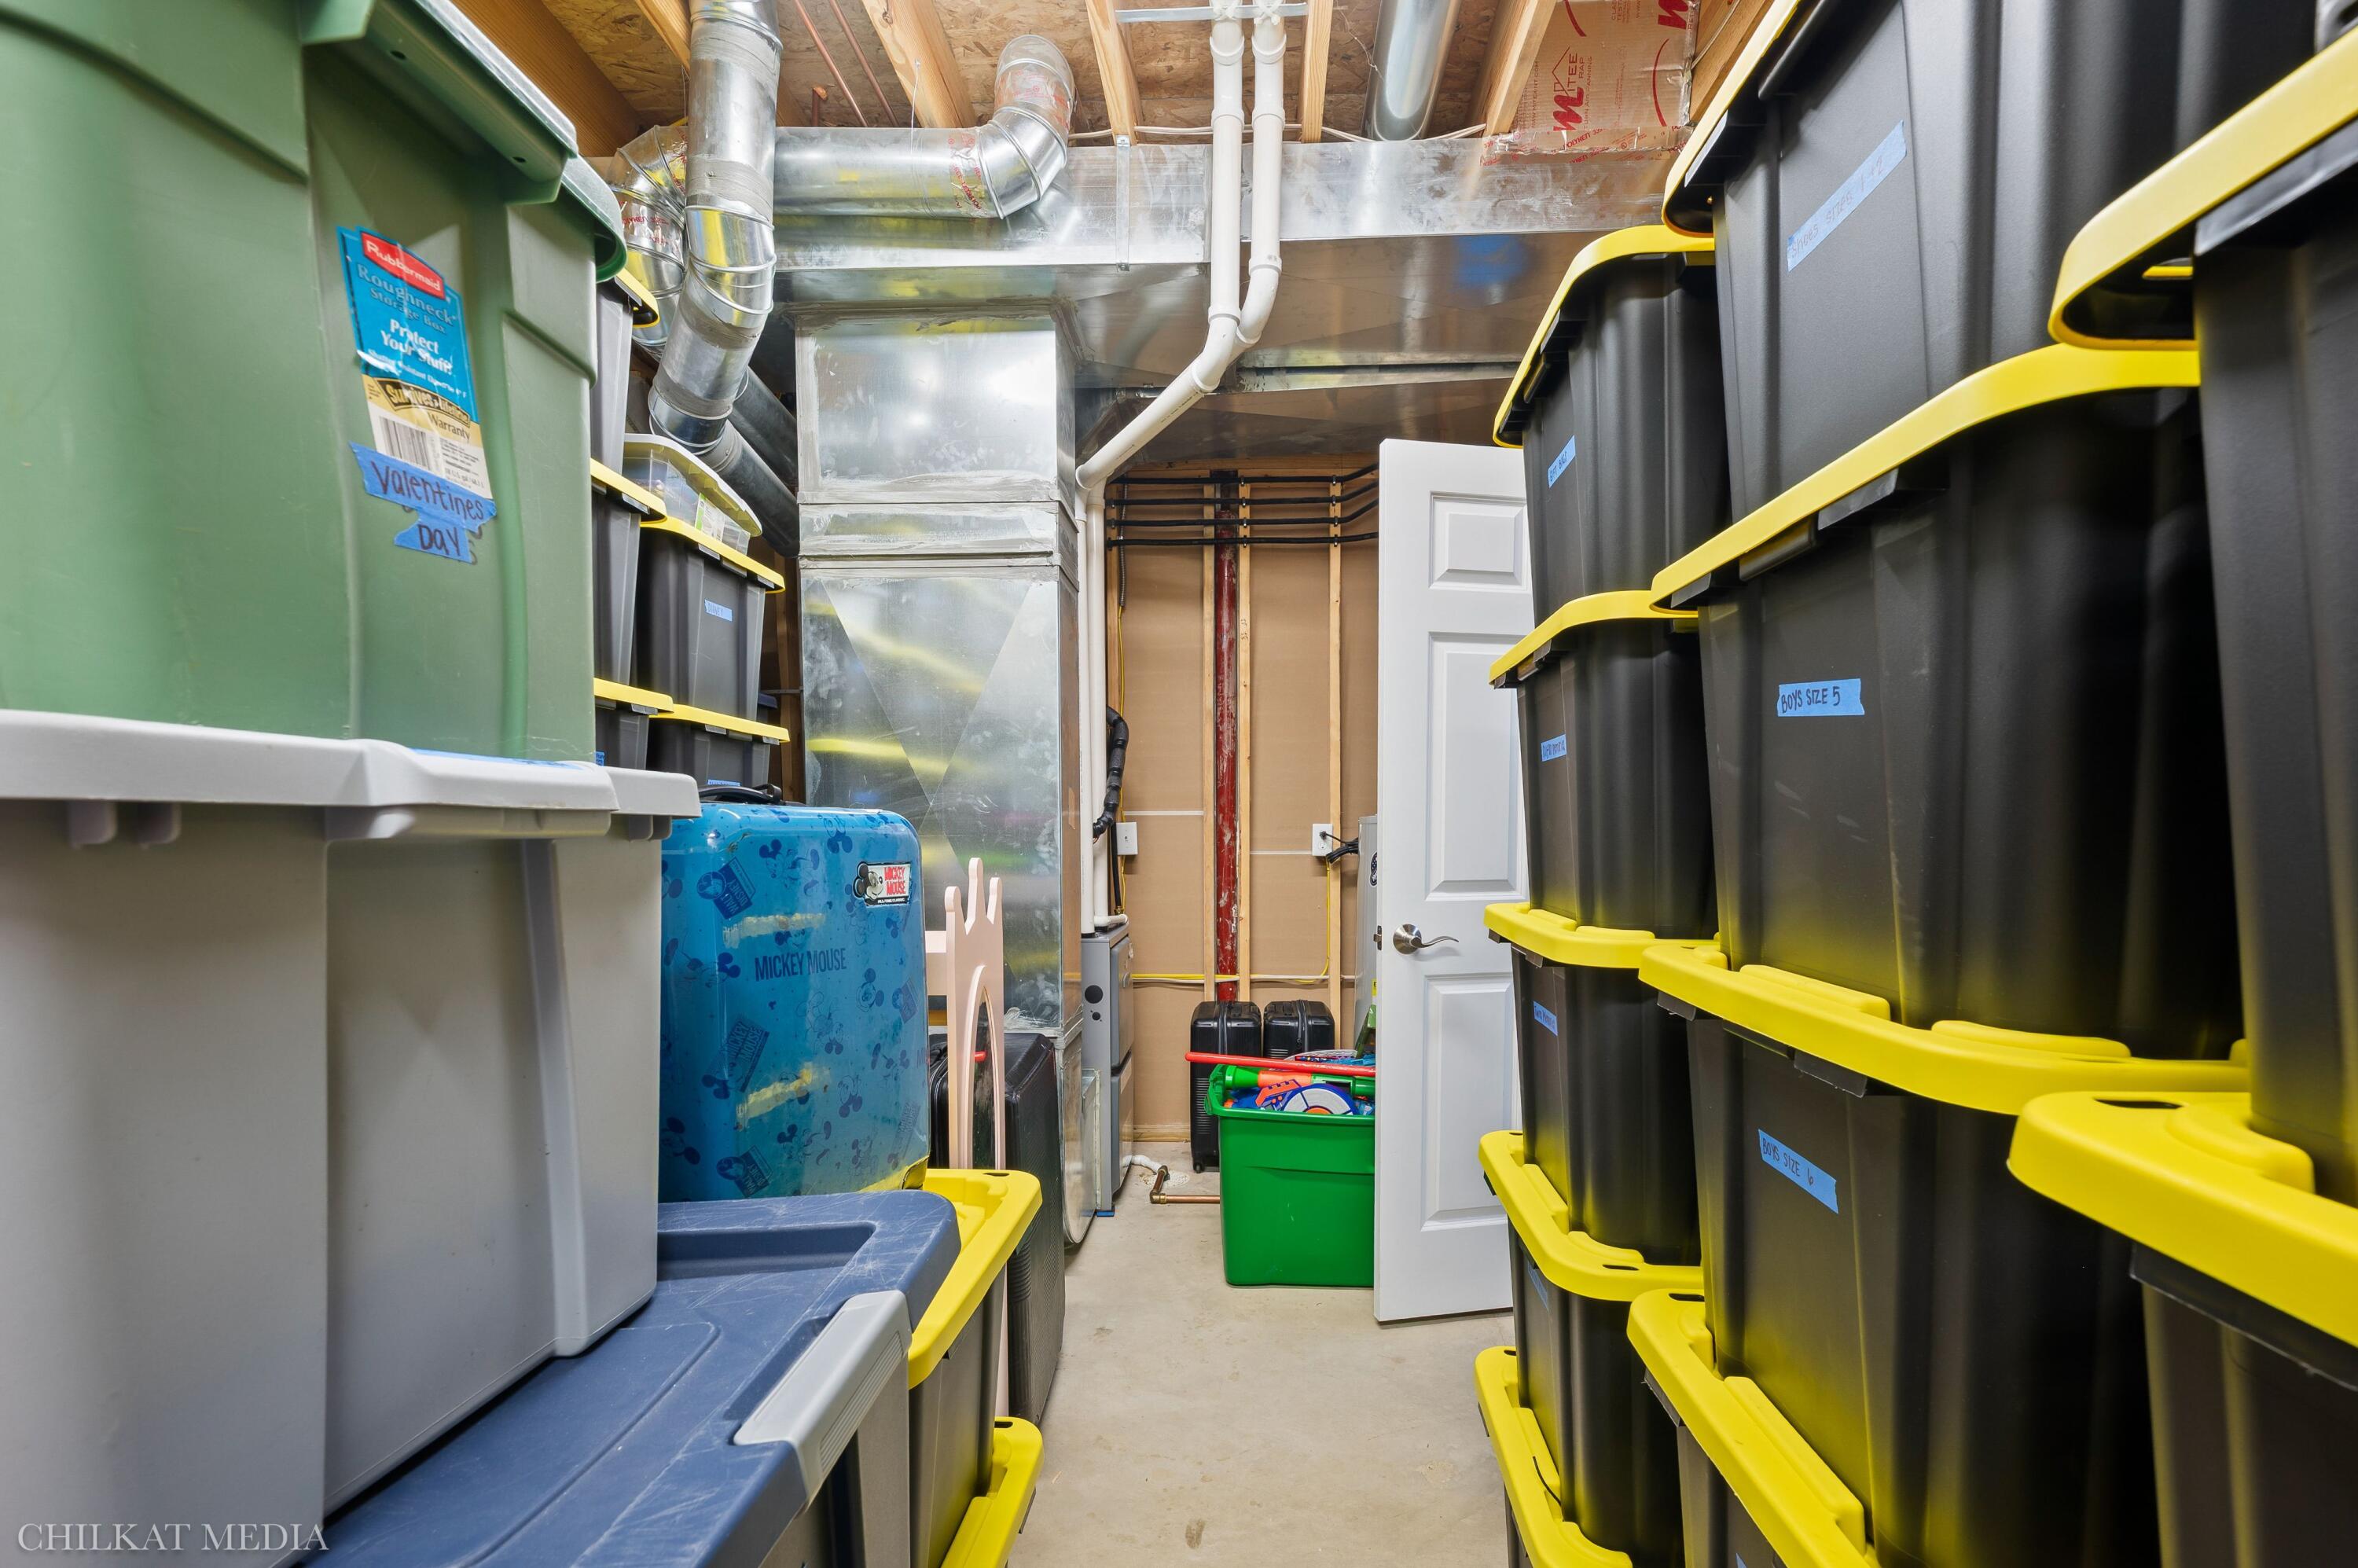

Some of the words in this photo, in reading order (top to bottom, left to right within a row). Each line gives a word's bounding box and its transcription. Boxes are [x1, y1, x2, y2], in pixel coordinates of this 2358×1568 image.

[365, 239, 442, 292] Rubbermaid
[357, 263, 454, 327] Roughneck
[370, 287, 420, 321] Storage
[380, 329, 413, 356] Your
[389, 318, 439, 354] Protect
[428, 411, 471, 442] Warranty
[371, 461, 484, 520] Valentines
[1781, 689, 1802, 713] BOYS
[1805, 688, 1828, 706] SIZE
[1832, 685, 1840, 707] 5
[883, 866, 905, 881] MICKEY
[886, 880, 906, 896] MOUSE
[755, 952, 804, 982] MICKEY
[806, 948, 847, 975] MOUSE
[1762, 1137, 1780, 1162] BOYS
[1783, 1151, 1801, 1177] SIZE
